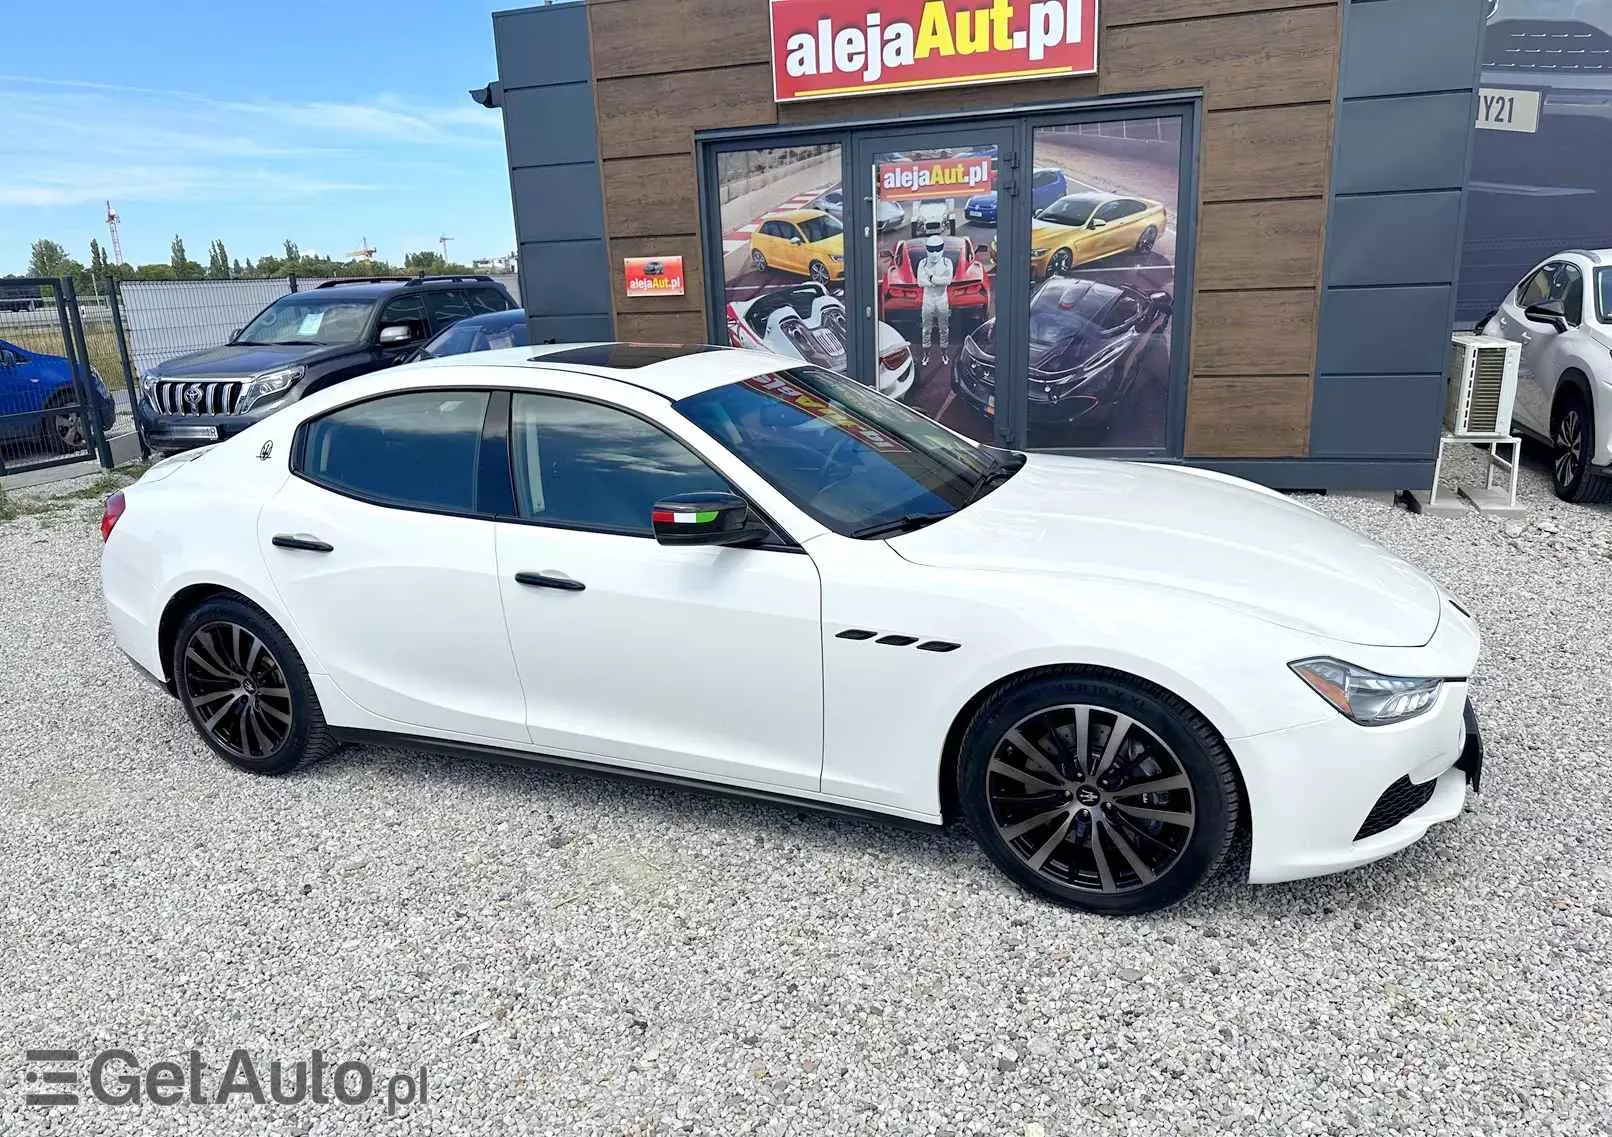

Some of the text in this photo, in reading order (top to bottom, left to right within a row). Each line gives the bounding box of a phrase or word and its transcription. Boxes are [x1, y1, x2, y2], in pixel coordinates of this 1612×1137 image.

[786, 0, 1082, 82] alejaAut.pl
[1476, 95, 1514, 123] Y21
[883, 160, 988, 191] alejaAut.pl
[629, 276, 681, 291] alejaAut.pl
